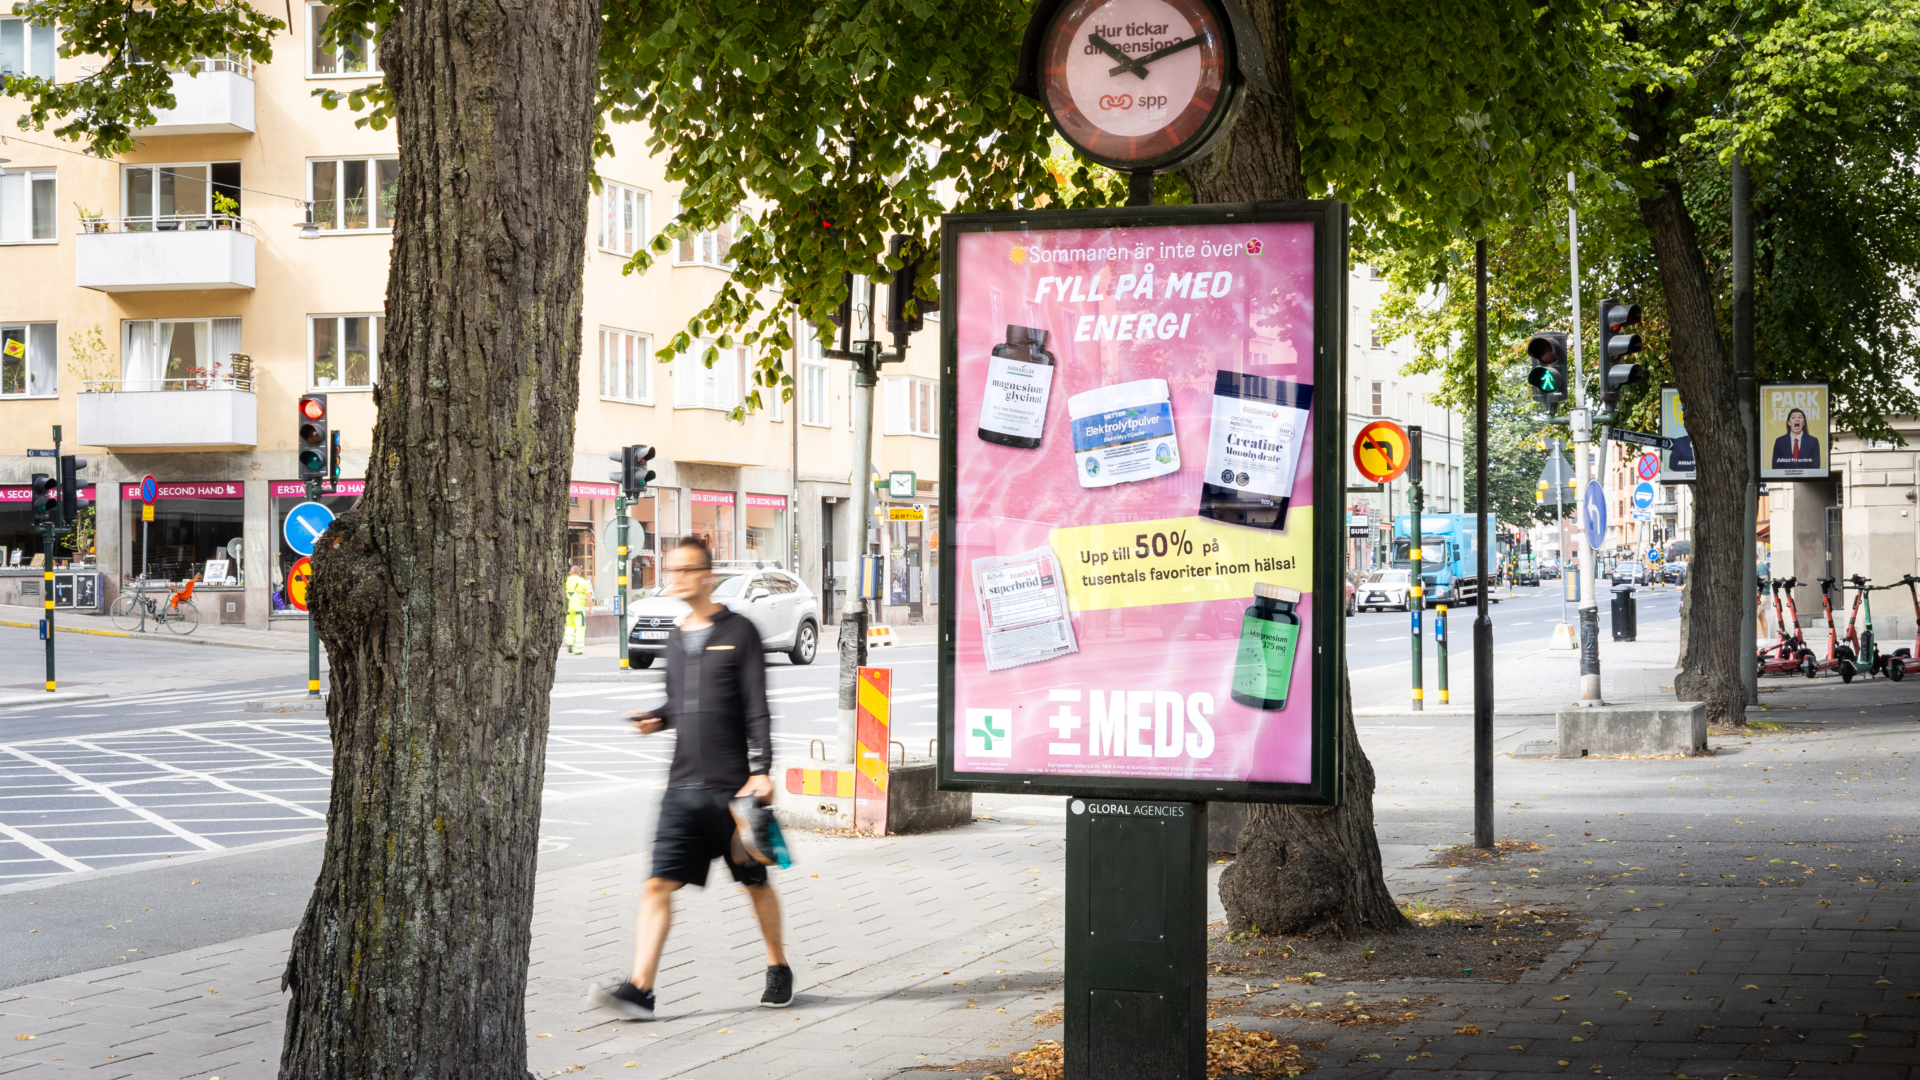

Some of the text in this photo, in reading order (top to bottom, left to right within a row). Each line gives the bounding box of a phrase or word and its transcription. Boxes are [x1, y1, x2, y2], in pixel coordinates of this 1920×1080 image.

[1094, 22, 1169, 38] Hur tickar
[1138, 95, 1168, 110] spp
[1029, 240, 1243, 263] Sommaren är inte över
[1034, 262, 1232, 304] FYLL PÅ MED
[1074, 313, 1192, 342] ENERGI
[1772, 391, 1820, 408] PARK
[1104, 410, 1126, 420] BETTER
[1772, 408, 1820, 421] TEARN
[1086, 416, 1160, 436] Elektrolytpulver
[1226, 433, 1283, 452] Creatine
[1226, 446, 1282, 462] Monohydrate
[158, 486, 224, 496] SECOND HAND
[278, 486, 305, 494] ERSTA
[578, 486, 598, 495] SECOND
[598, 488, 610, 496] HAND
[1080, 530, 1220, 566] Upp till 50% på
[1082, 556, 1296, 587] tusentals favoriter inom hälsa!
[988, 576, 1040, 596] superbröd
[1250, 630, 1288, 643] Magnesium
[1262, 640, 1286, 654] 375 mg
[1088, 690, 1216, 759] MEDS
[1088, 804, 1184, 816] GLOBAL AGENCIES
